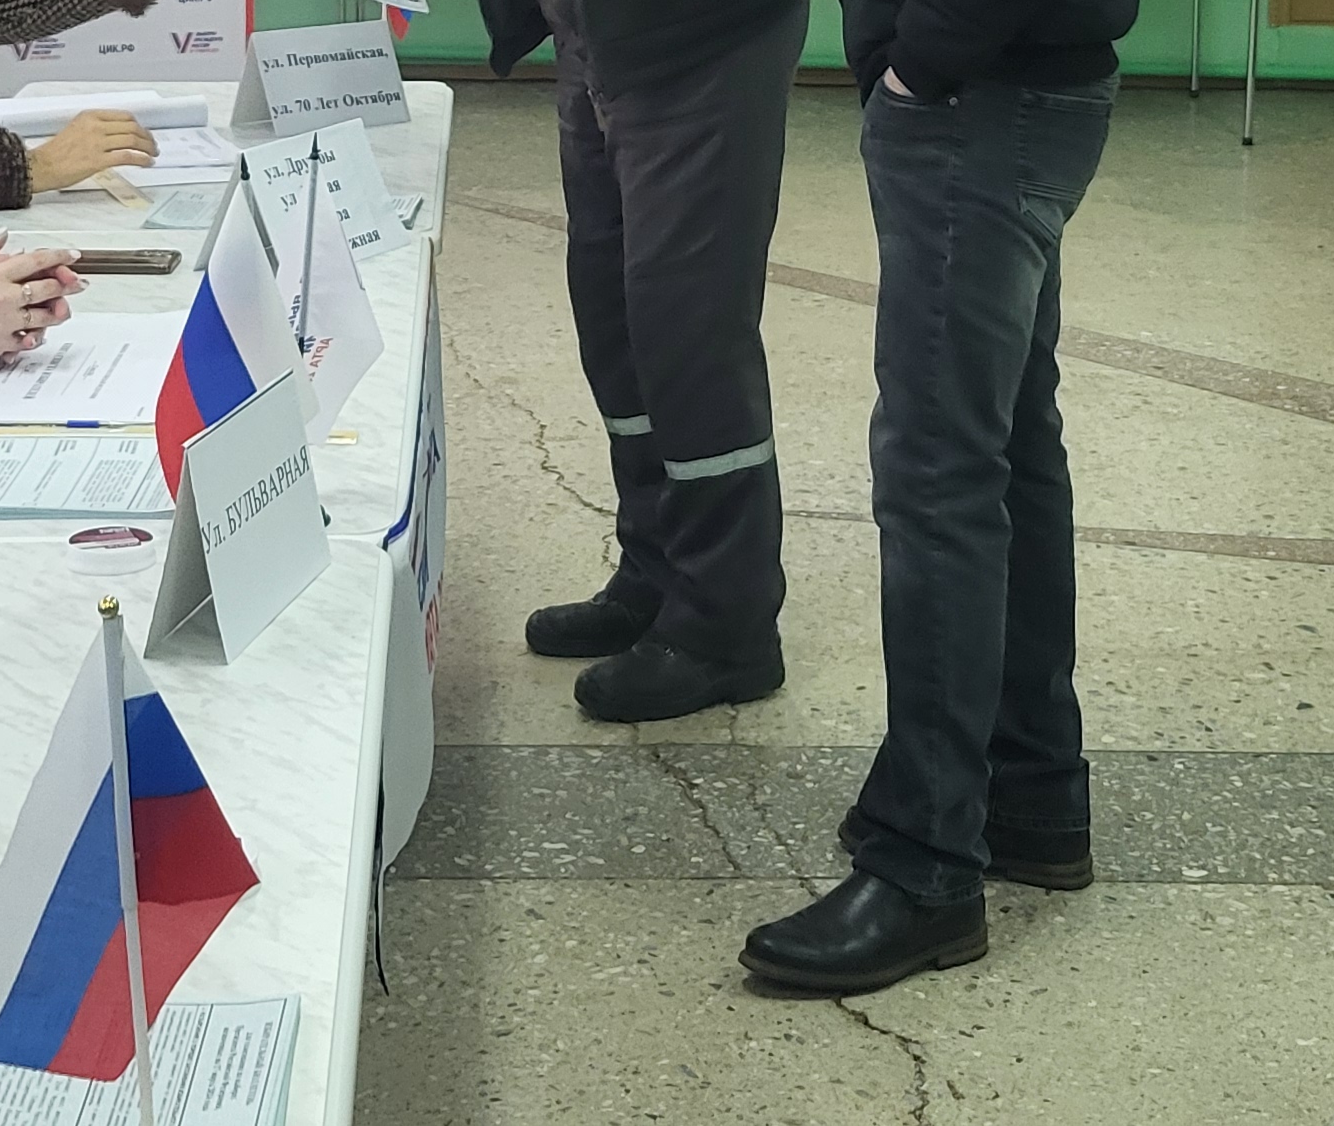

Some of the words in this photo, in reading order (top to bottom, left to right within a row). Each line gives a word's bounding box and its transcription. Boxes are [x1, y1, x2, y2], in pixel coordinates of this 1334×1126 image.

[262, 58, 284, 73] ул.
[287, 48, 388, 68] Первомайская,
[271, 104, 293, 119] ул.
[295, 99, 312, 113] 70
[314, 97, 339, 110] Лет
[342, 90, 401, 106] Октября
[263, 166, 284, 185] ул.
[284, 150, 336, 178] Друбы
[348, 229, 381, 250] жная
[201, 520, 226, 554] Ул.
[225, 444, 310, 536] БУЛЬВАРНАЯ
